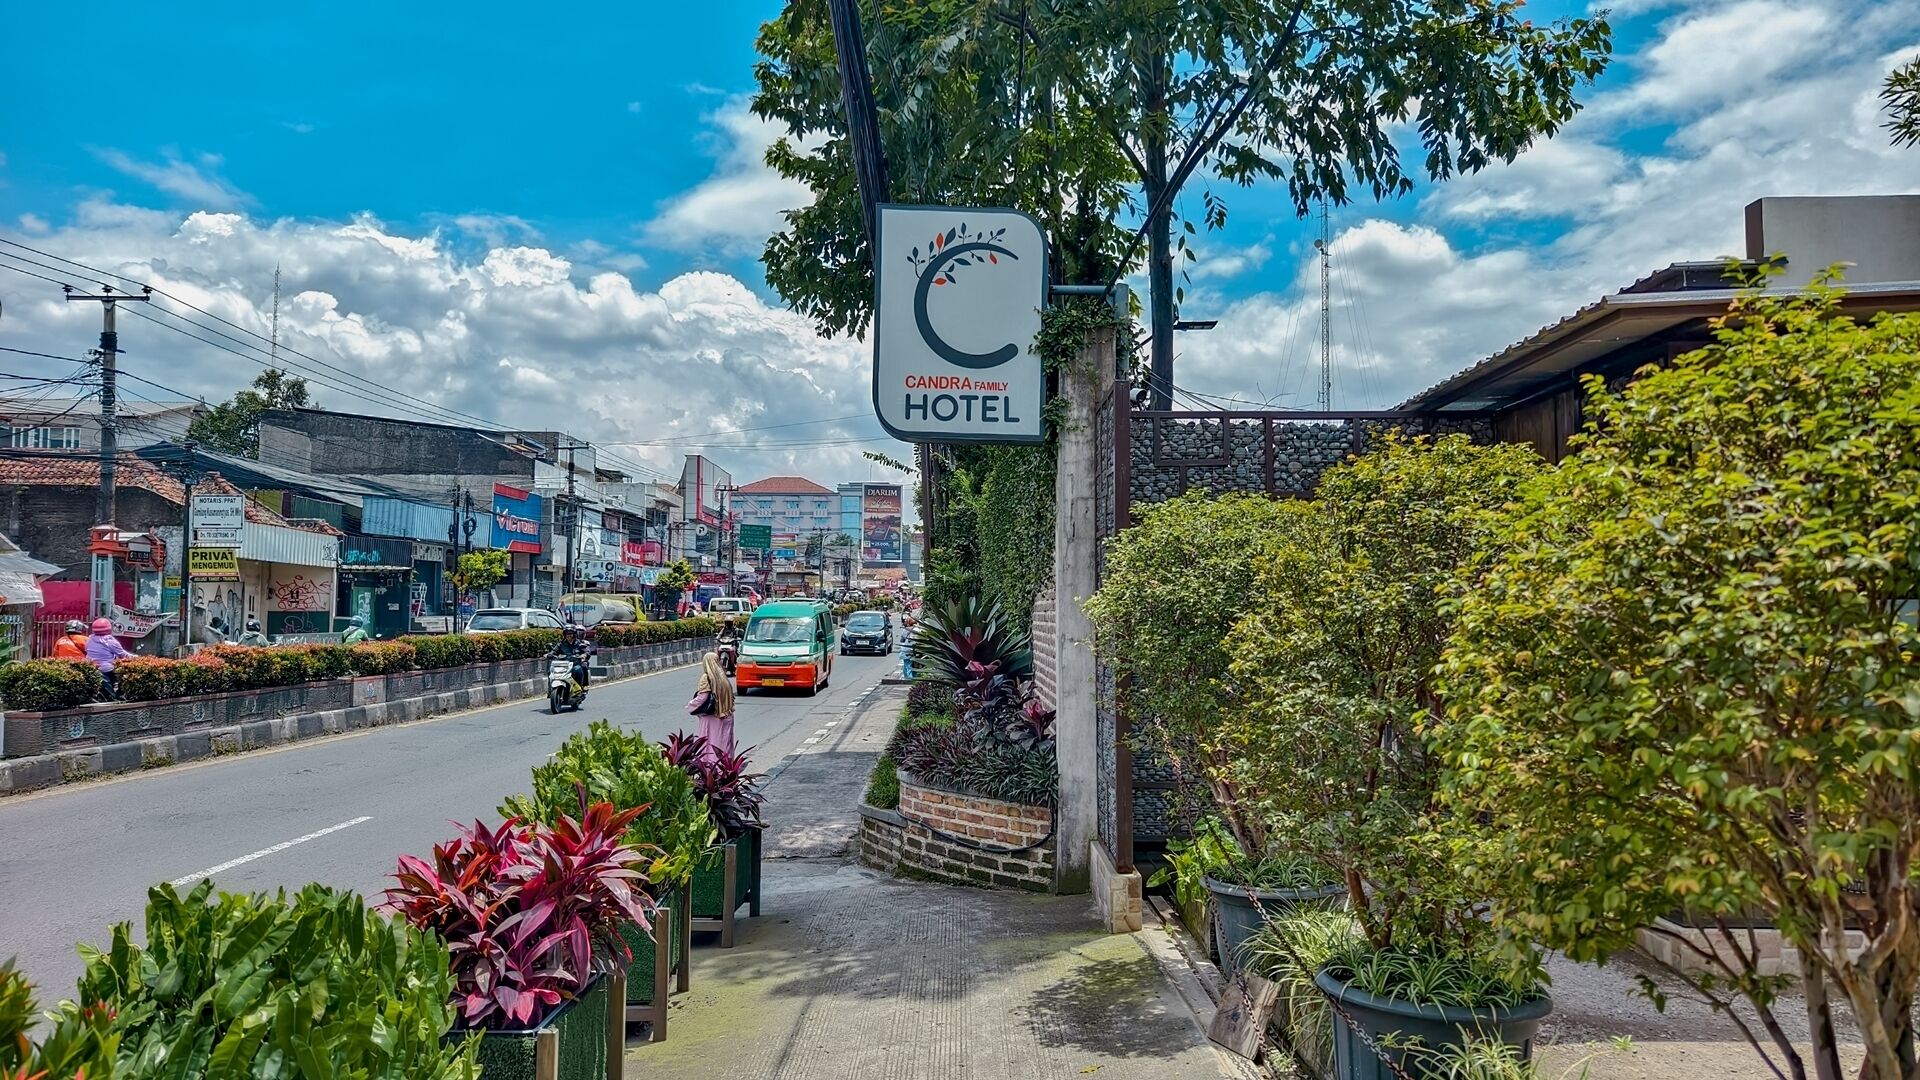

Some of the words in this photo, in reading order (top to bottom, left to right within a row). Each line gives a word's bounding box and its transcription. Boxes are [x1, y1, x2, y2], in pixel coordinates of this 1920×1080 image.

[905, 375, 972, 390] CANDRA
[974, 381, 1009, 391] FAMILY
[905, 393, 1020, 423] HOTEL
[496, 506, 539, 535] VICTORY
[192, 552, 233, 561] PRIVAT
